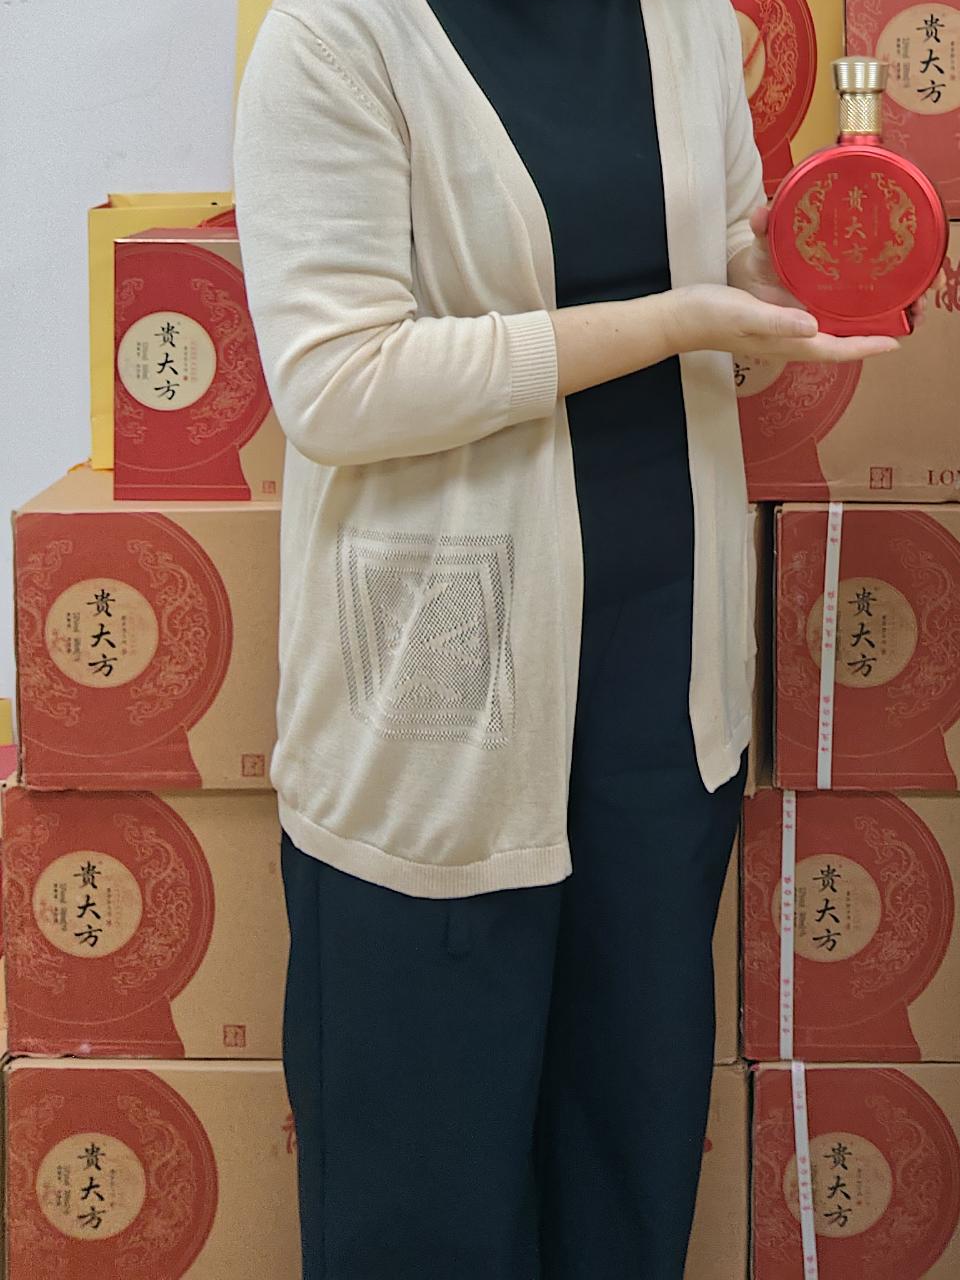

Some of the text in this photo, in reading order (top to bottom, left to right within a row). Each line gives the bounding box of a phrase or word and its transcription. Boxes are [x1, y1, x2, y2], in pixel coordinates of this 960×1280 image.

[916, 14, 946, 104] 贵大方
[154, 322, 180, 401] 贵大方
[87, 588, 118, 677] 贵大方
[847, 587, 877, 678] 贵大方
[74, 860, 103, 948] 贵大方
[812, 864, 841, 952] 贵大方
[78, 1143, 106, 1230] 贵大方
[823, 1142, 853, 1228] 贵大方
